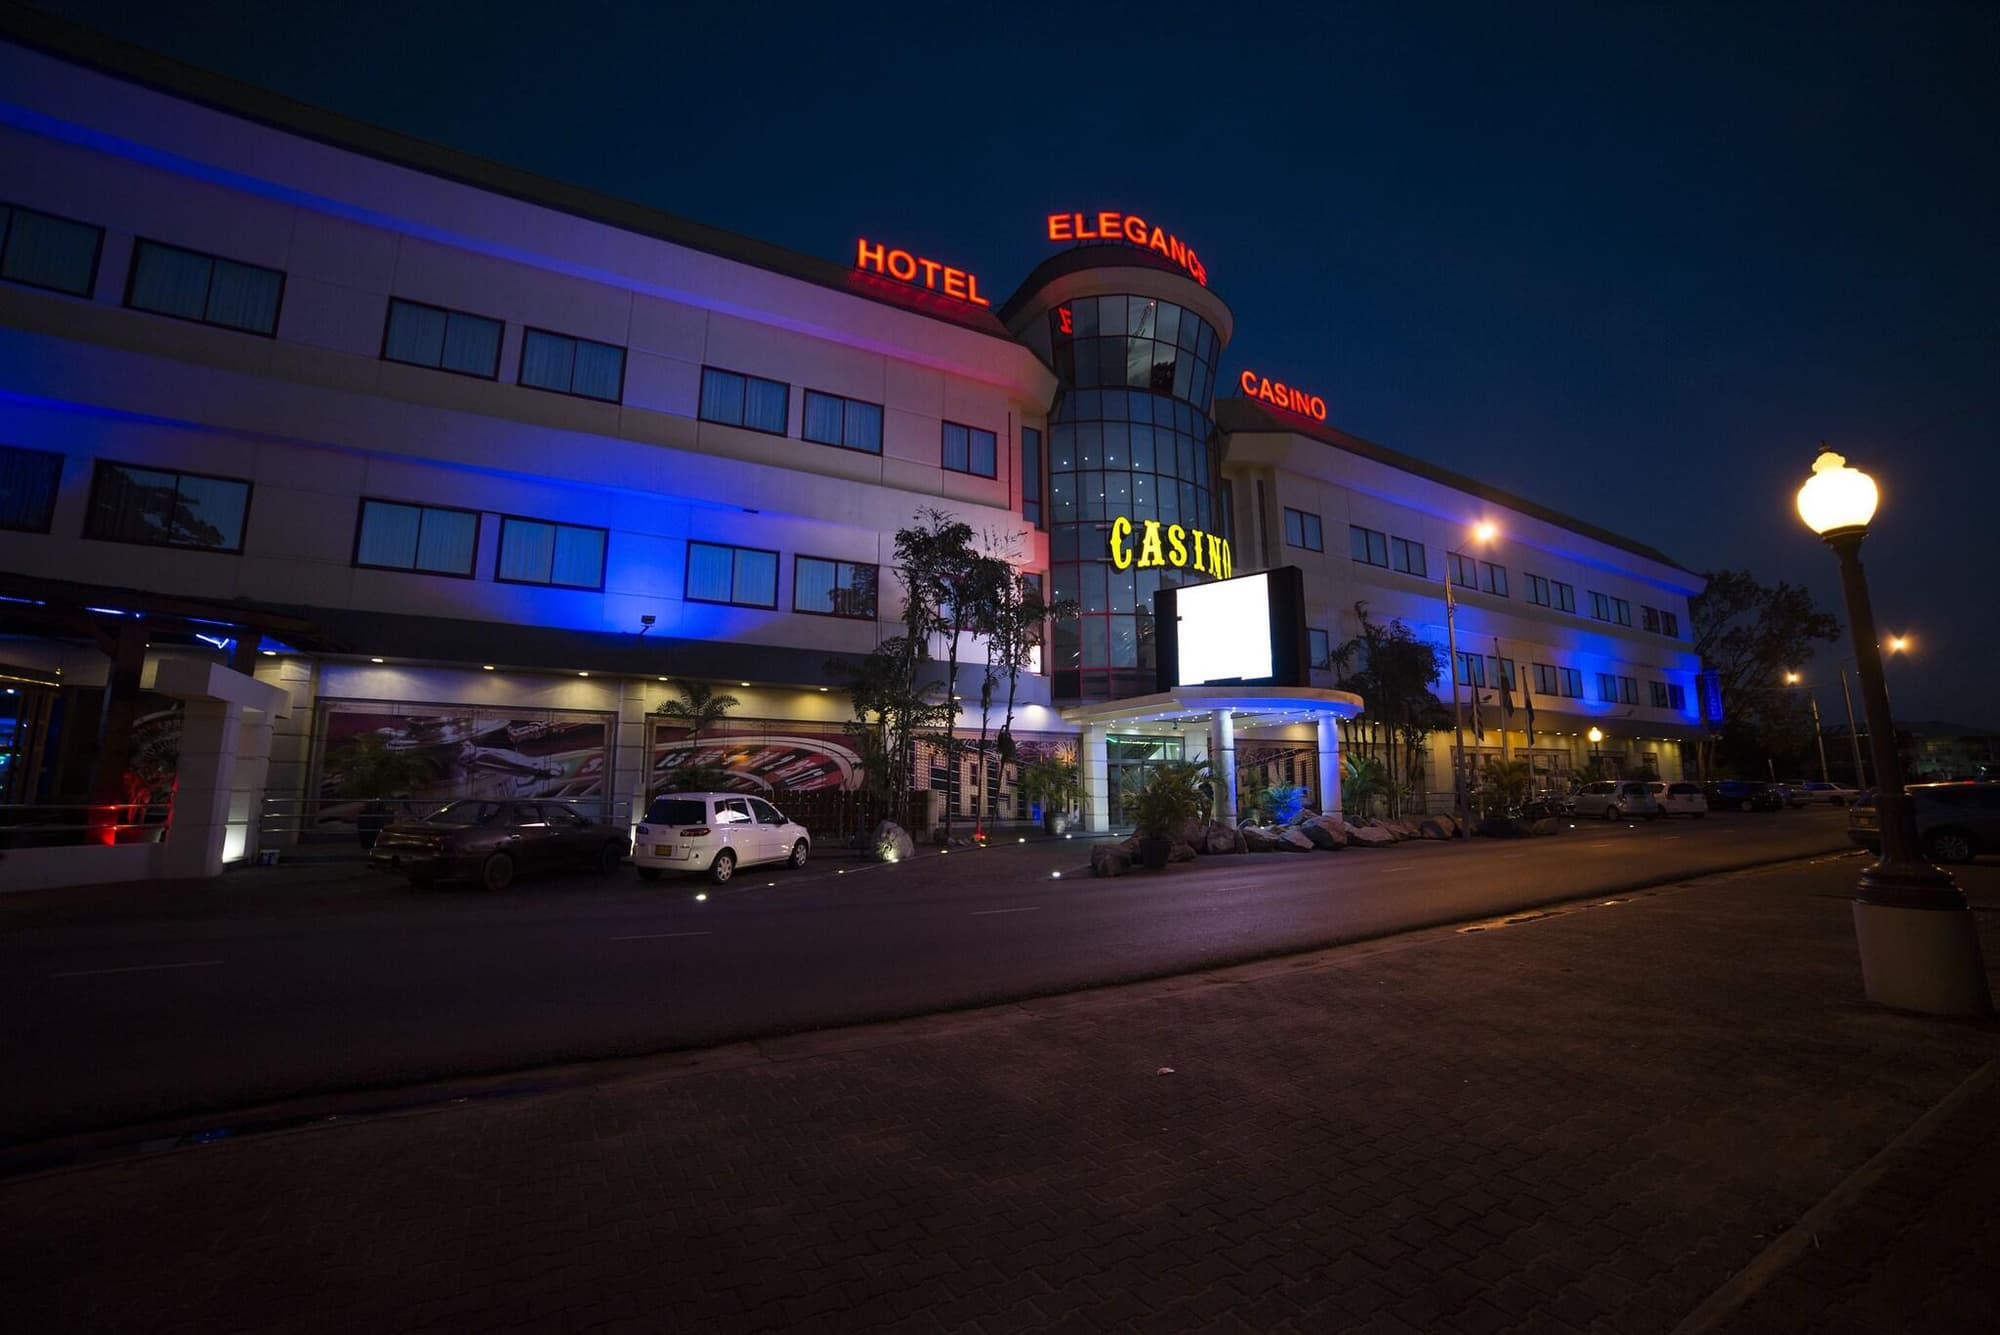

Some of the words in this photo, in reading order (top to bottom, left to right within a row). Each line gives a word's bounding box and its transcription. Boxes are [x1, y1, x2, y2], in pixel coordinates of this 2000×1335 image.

[857, 237, 990, 307] HOTEL
[1048, 211, 1207, 287] ELEGANCE
[1240, 370, 1326, 420] CASINO
[1110, 516, 1232, 580] CASINO
